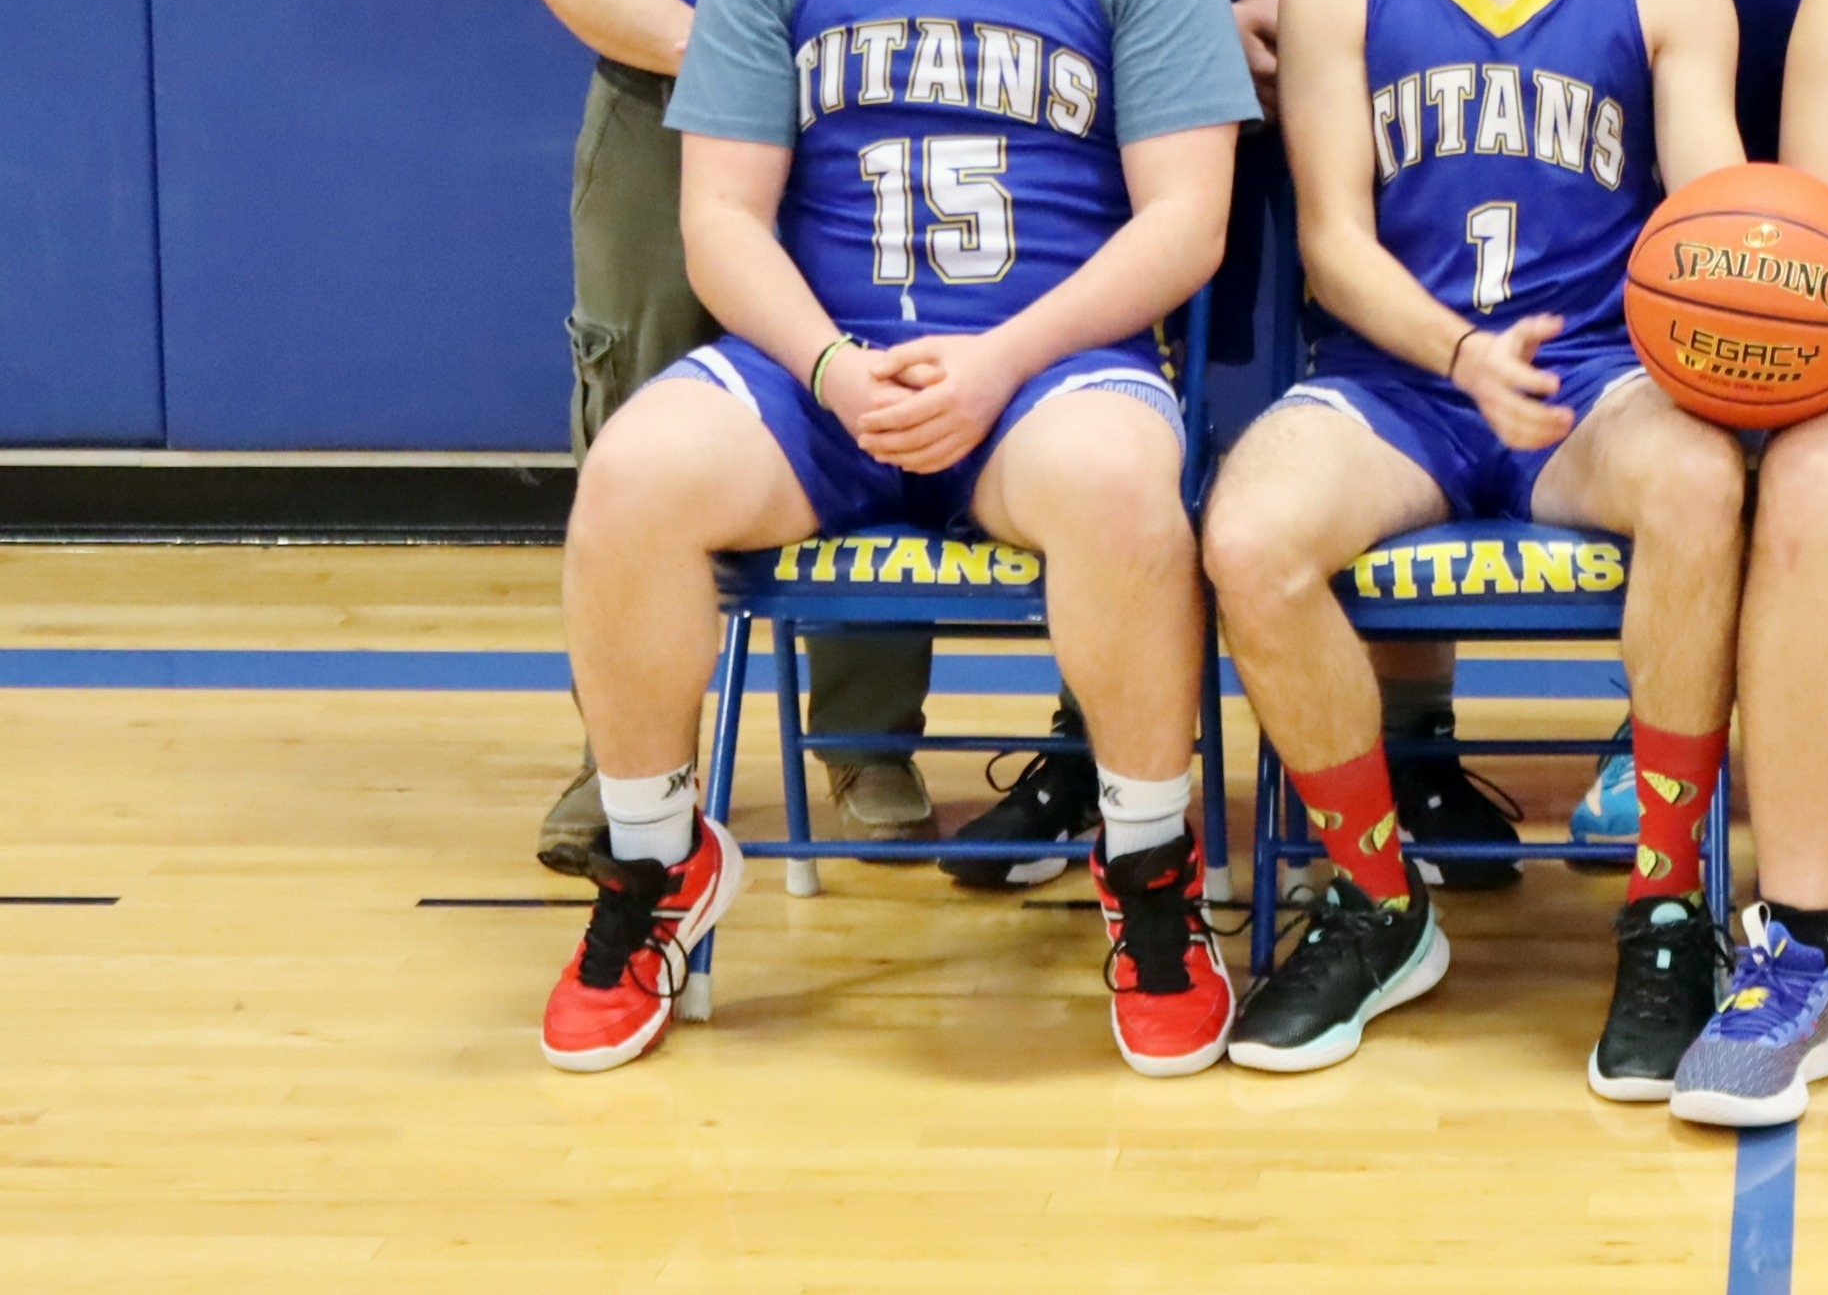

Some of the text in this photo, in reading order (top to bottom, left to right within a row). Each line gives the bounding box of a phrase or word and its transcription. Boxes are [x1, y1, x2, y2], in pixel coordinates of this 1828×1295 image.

[858, 135, 1016, 285] 15
[1466, 200, 1518, 315] 1
[1669, 319, 1820, 367] LEGACY
[774, 536, 1041, 586] TITANS
[1346, 540, 1625, 599] TITANS
